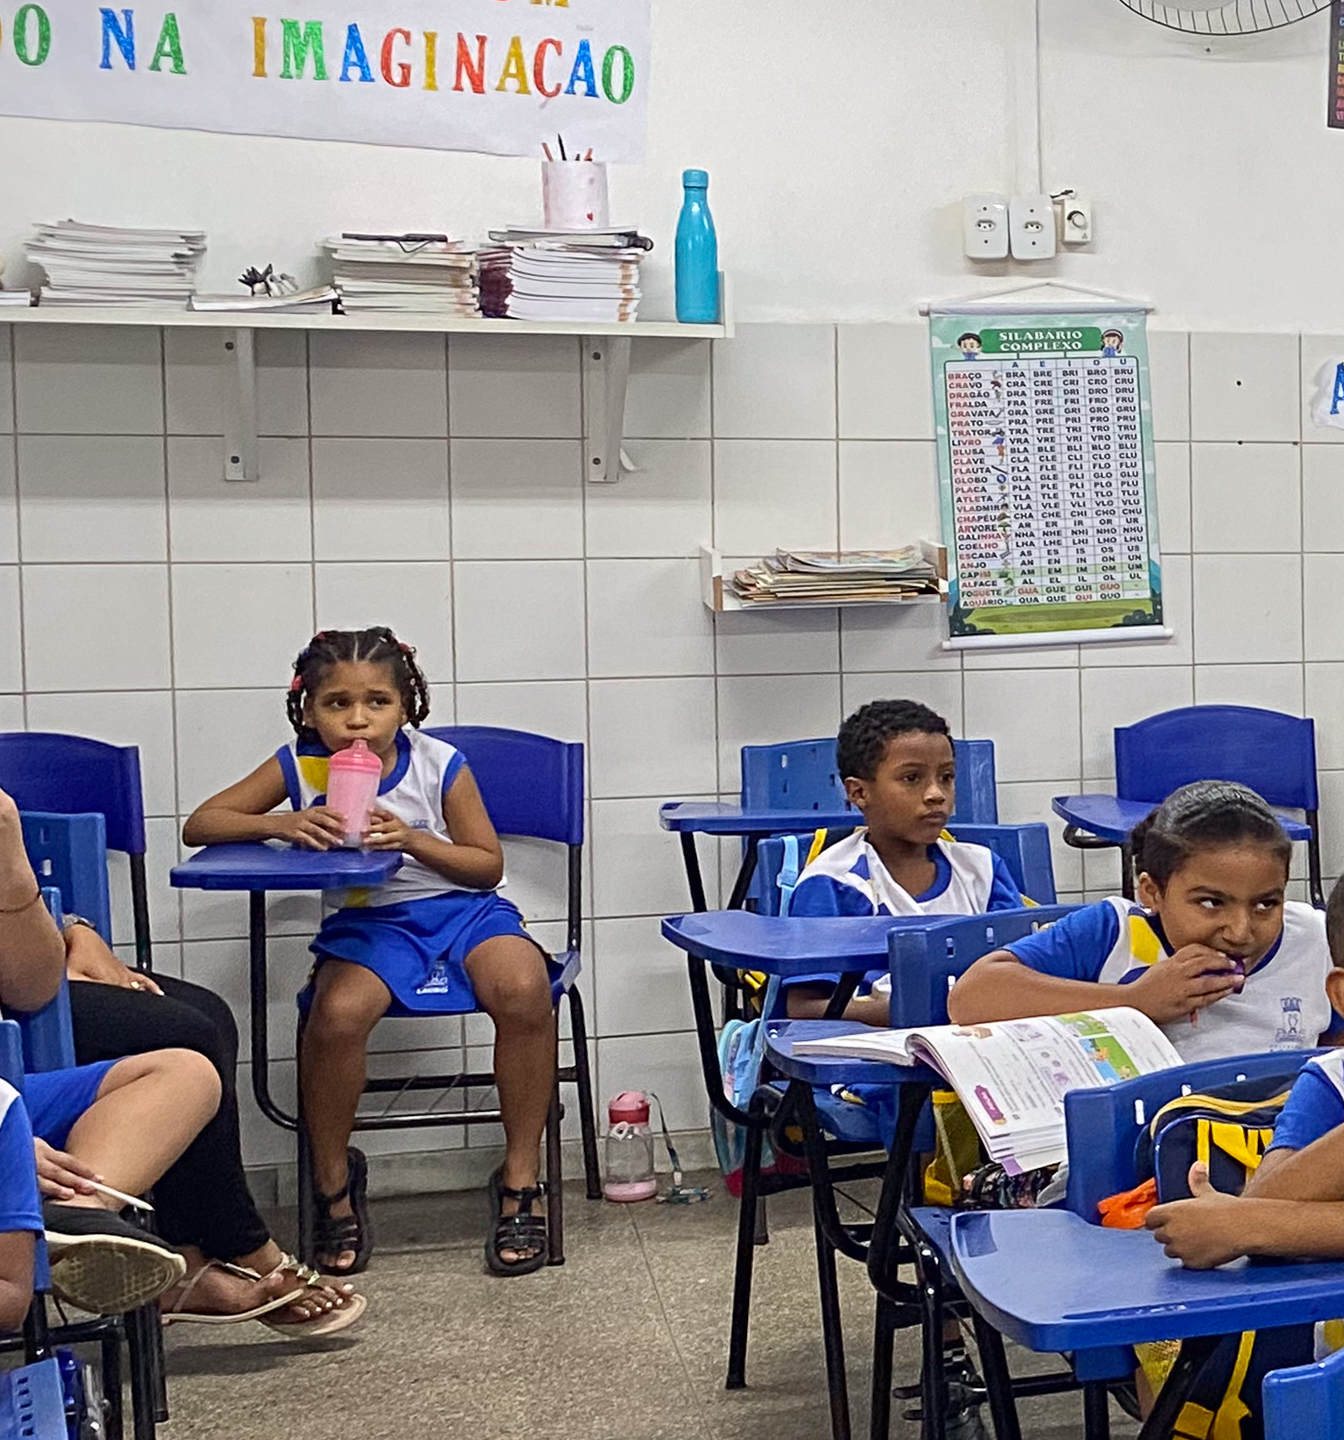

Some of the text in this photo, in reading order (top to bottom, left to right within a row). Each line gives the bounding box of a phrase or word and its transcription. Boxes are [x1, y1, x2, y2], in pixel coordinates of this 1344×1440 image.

[100, 7, 187, 75] NA
[999, 329, 1082, 341] SILABÁRIO
[1000, 341, 1082, 351] COMPLEXO
